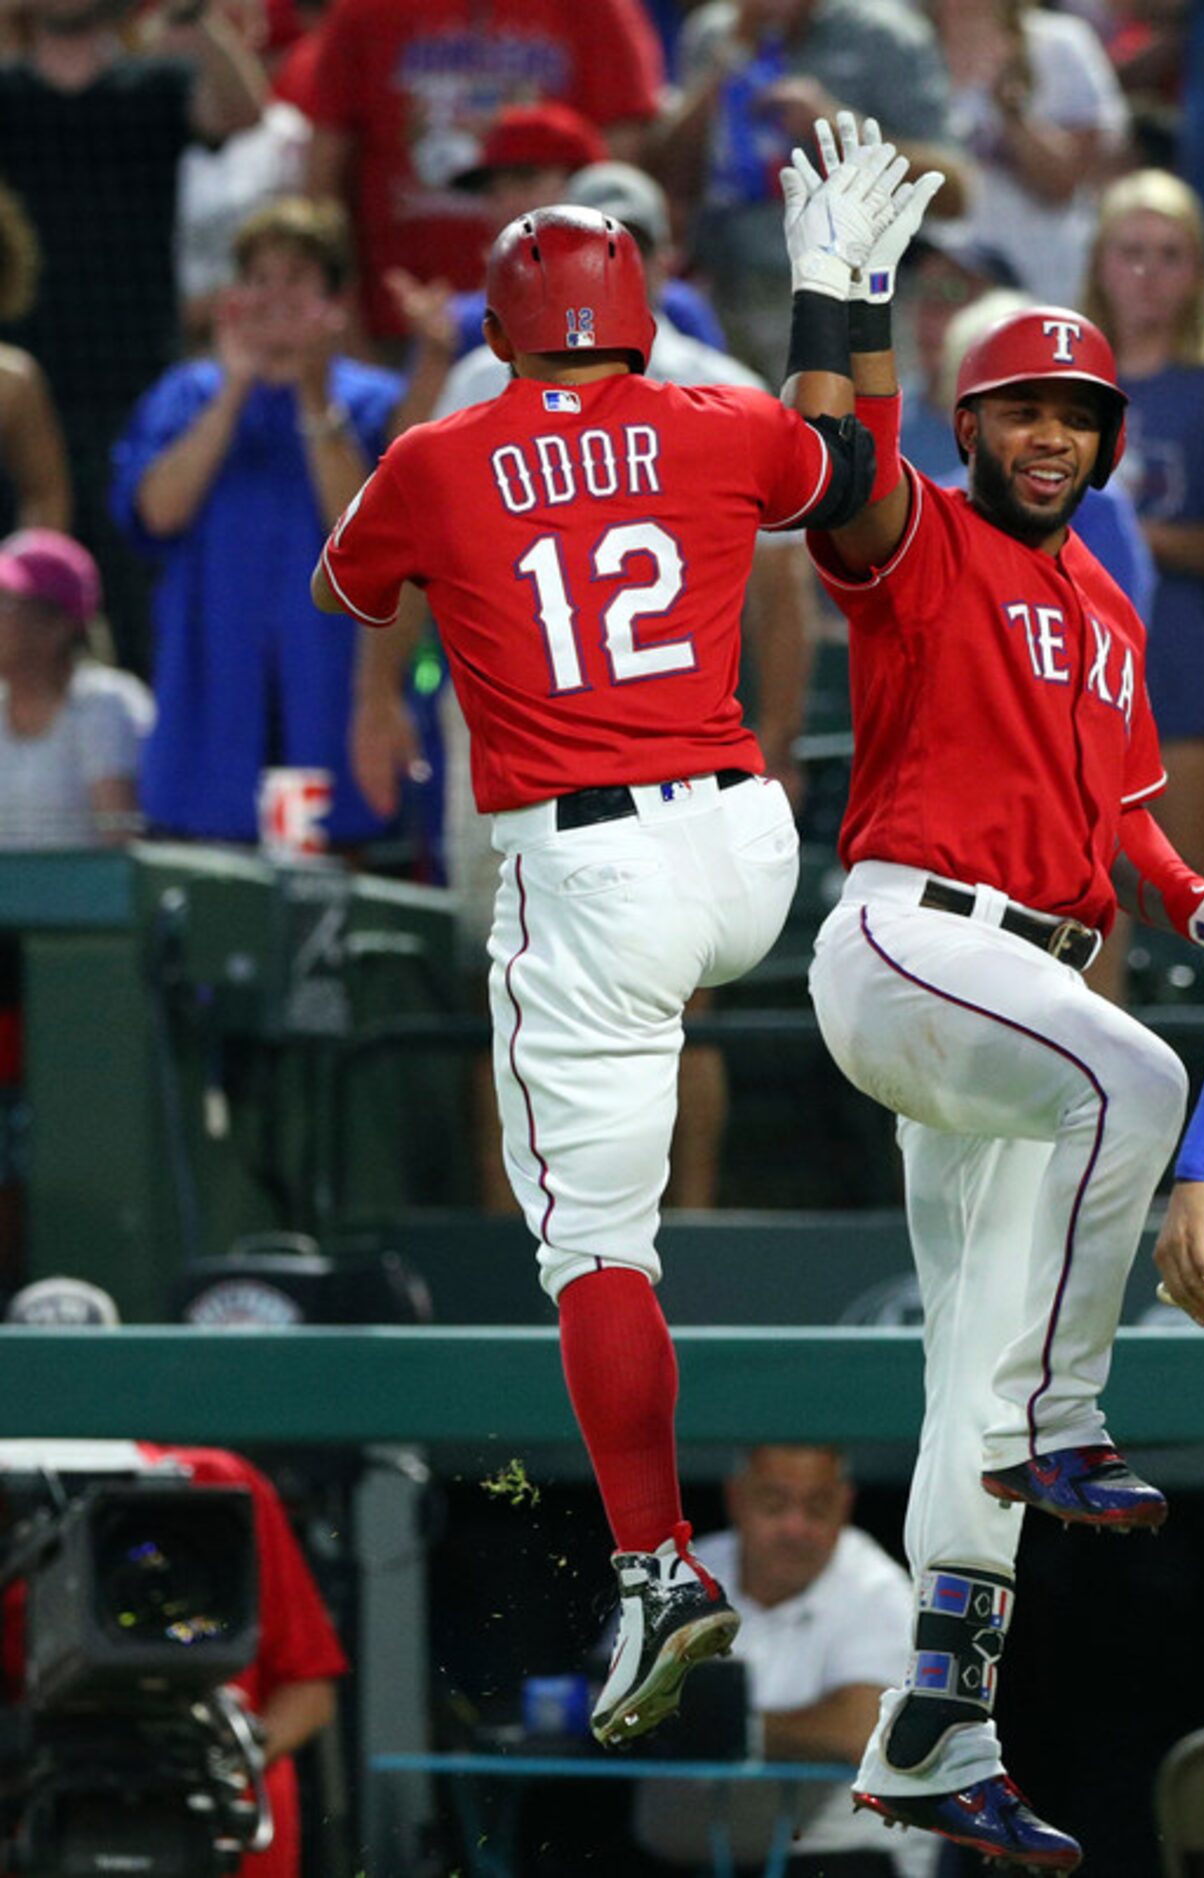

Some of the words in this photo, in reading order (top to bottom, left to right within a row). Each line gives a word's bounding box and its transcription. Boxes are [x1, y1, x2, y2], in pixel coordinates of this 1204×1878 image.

[566, 308, 593, 332] 12
[1042, 320, 1083, 365] T
[490, 424, 664, 516] ODOR
[513, 517, 700, 697] 12
